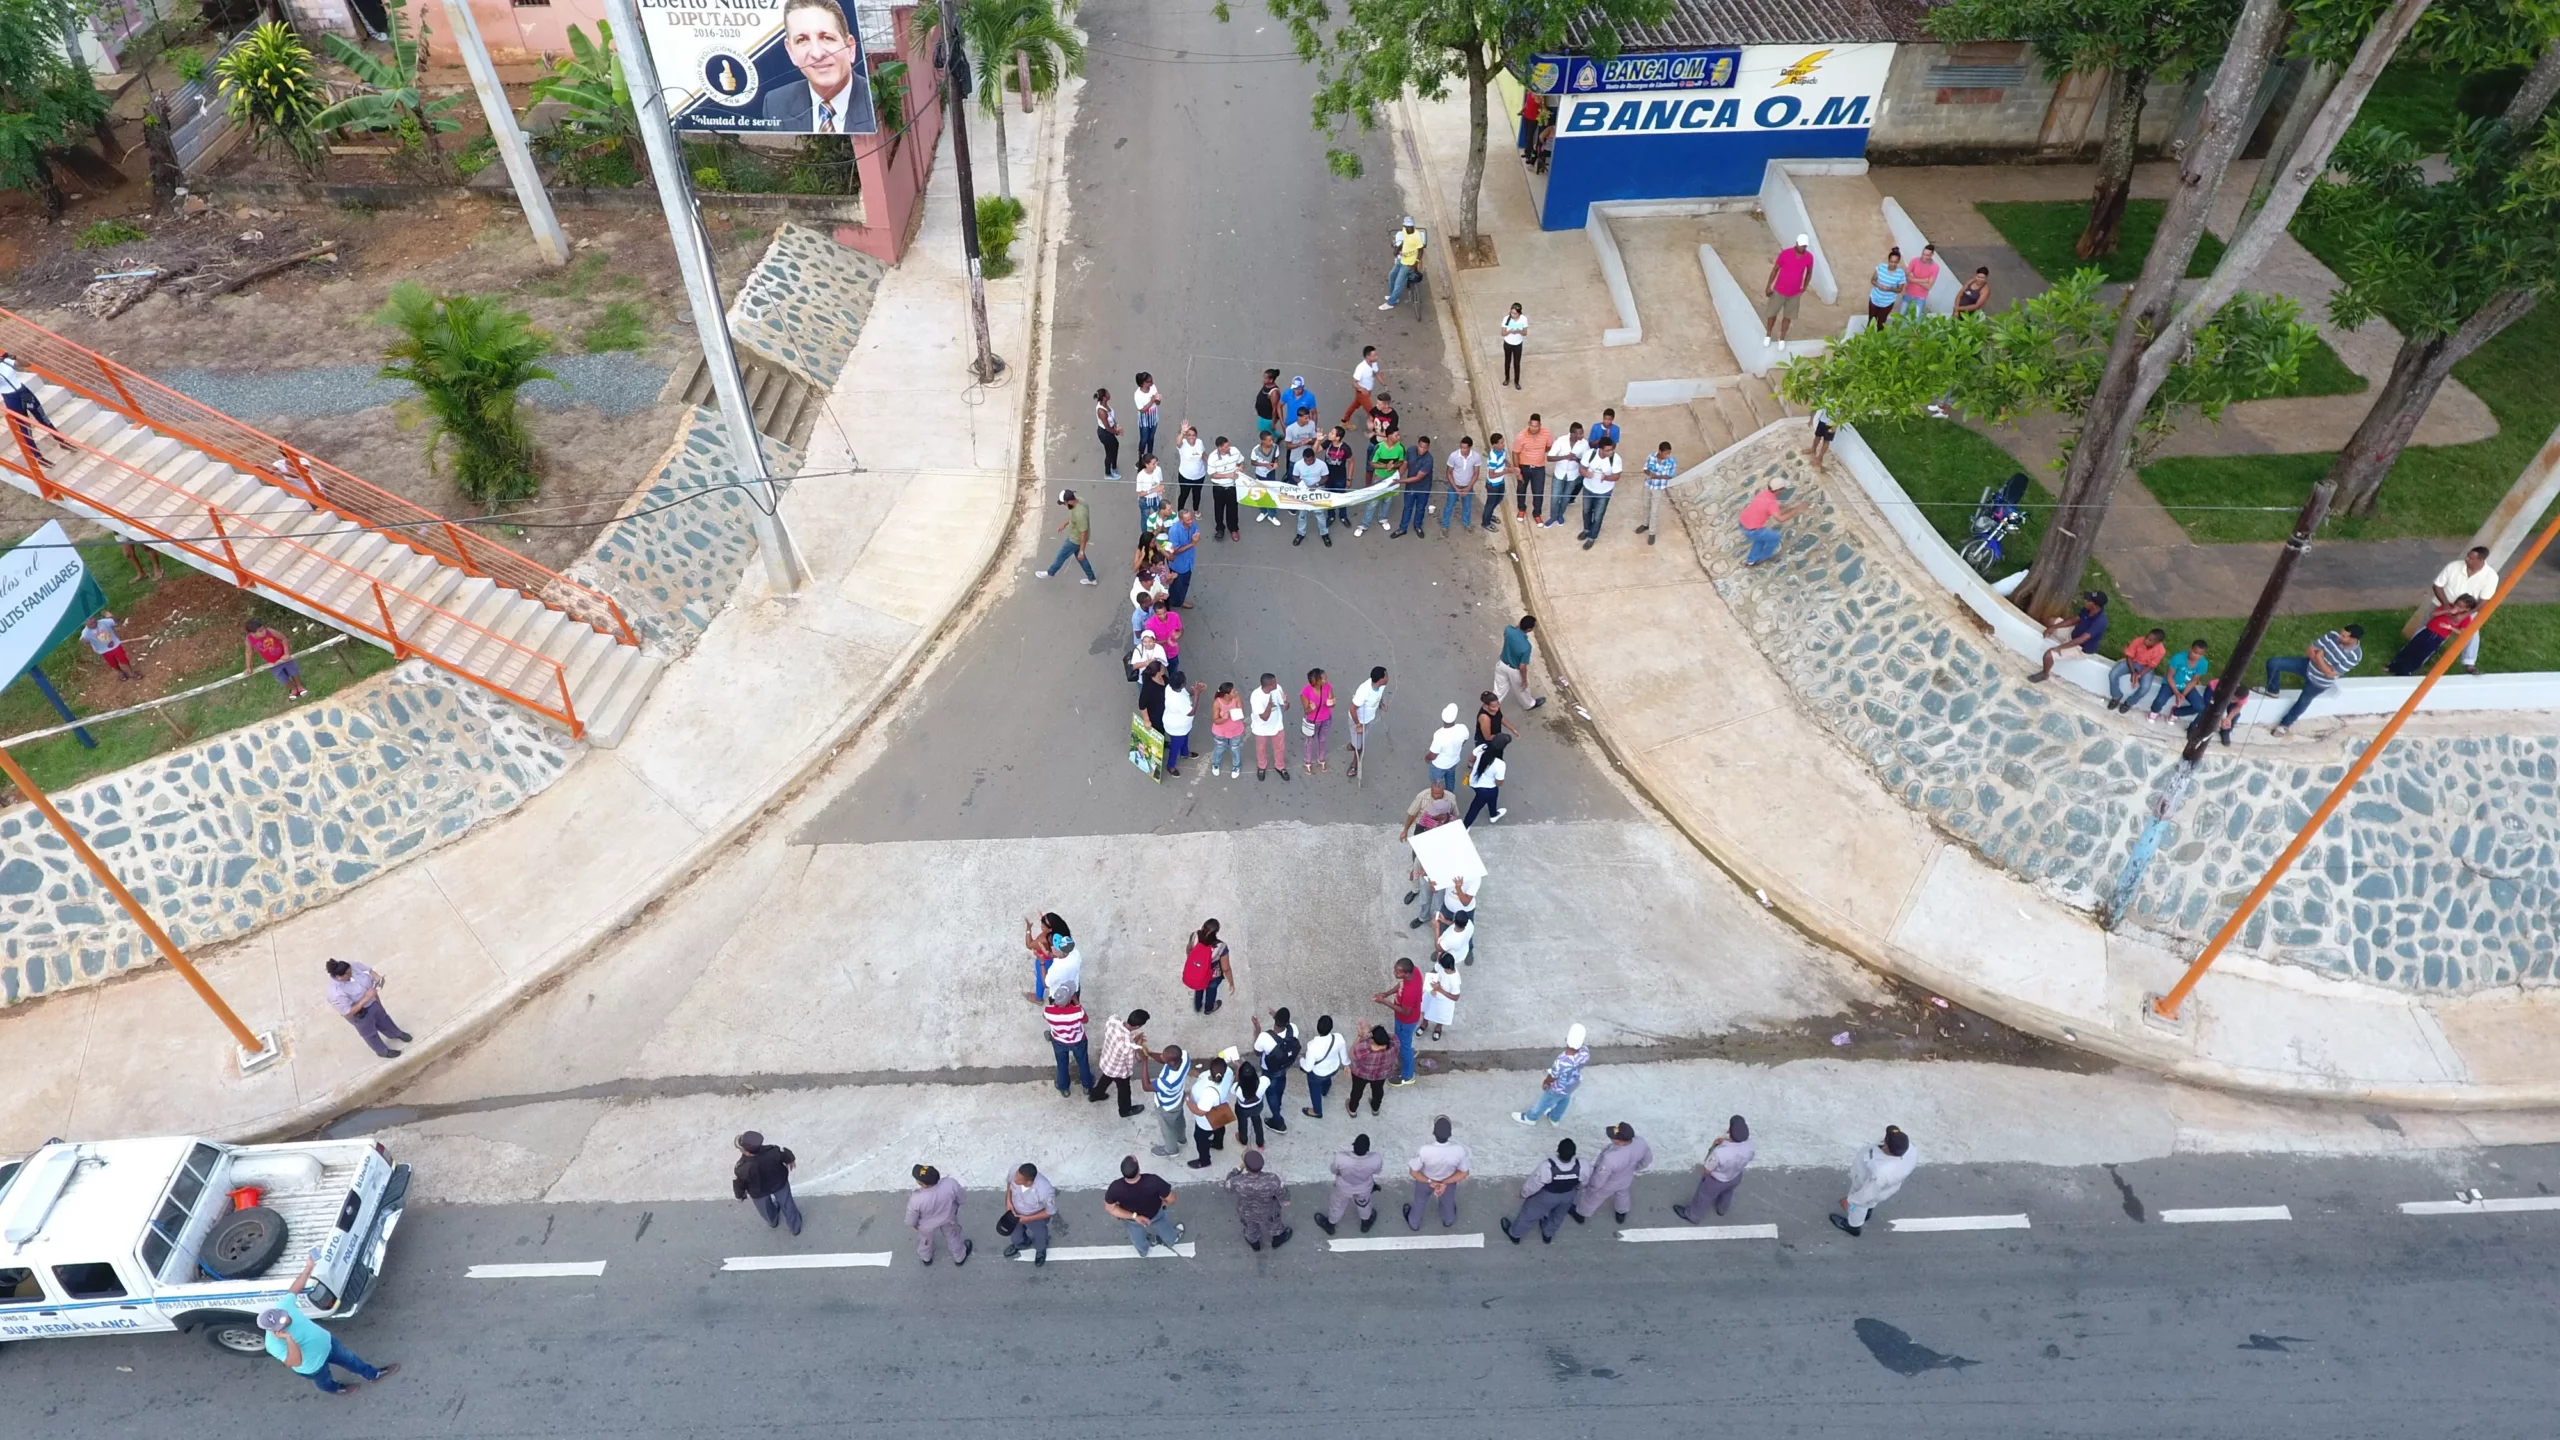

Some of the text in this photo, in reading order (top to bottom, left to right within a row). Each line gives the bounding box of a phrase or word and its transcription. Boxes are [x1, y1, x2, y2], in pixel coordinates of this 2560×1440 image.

[666, 11, 761, 26] DIPUTADO
[693, 28, 741, 38] 2016-2020
[1602, 59, 1669, 82] BANCA
[697, 70, 717, 99] PARTIDO
[690, 114, 782, 127] Voluntad de servir
[1565, 95, 1872, 132] BANCA O.M.
[25, 550, 40, 578] al
[21, 560, 80, 612] FAMILIARES
[342, 1233, 360, 1264] POLICIA
[2, 1318, 140, 1335] SUP. PIEDRA BLANCA
